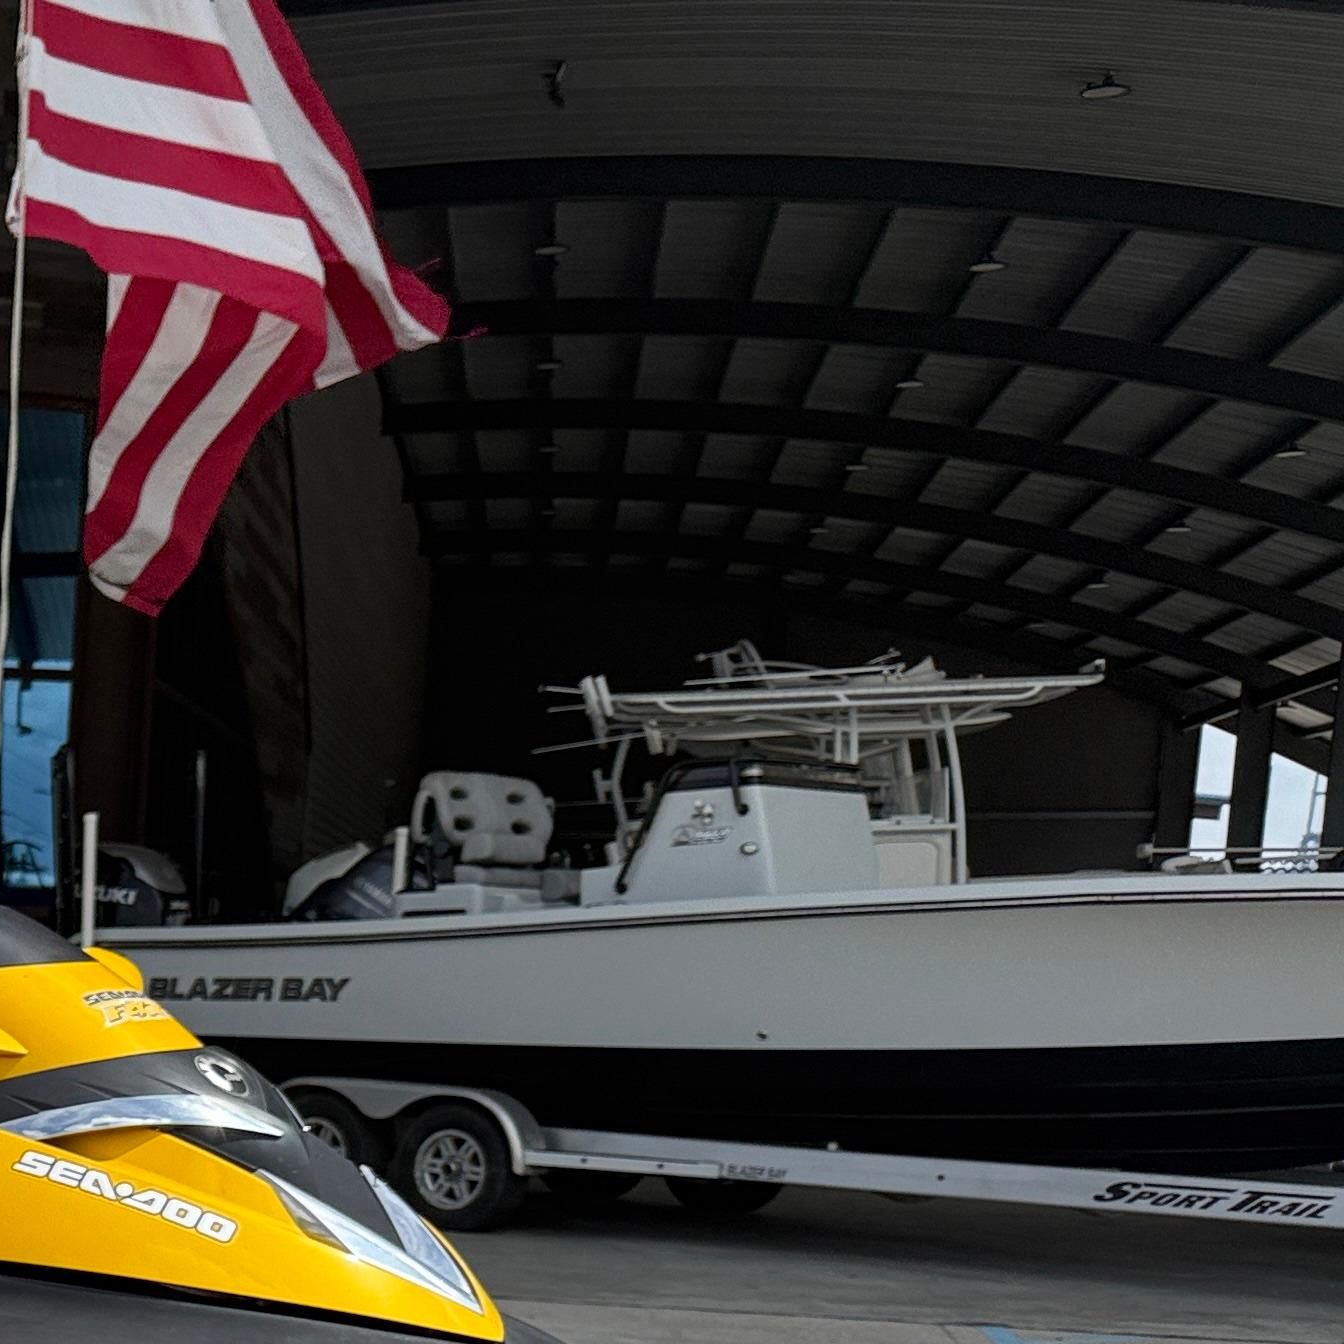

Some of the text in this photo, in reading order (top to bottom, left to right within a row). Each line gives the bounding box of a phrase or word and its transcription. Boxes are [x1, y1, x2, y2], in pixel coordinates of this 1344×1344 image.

[148, 977, 350, 1002] BLAZER BAY
[1093, 1181, 1336, 1219] SPORT TRAIL
